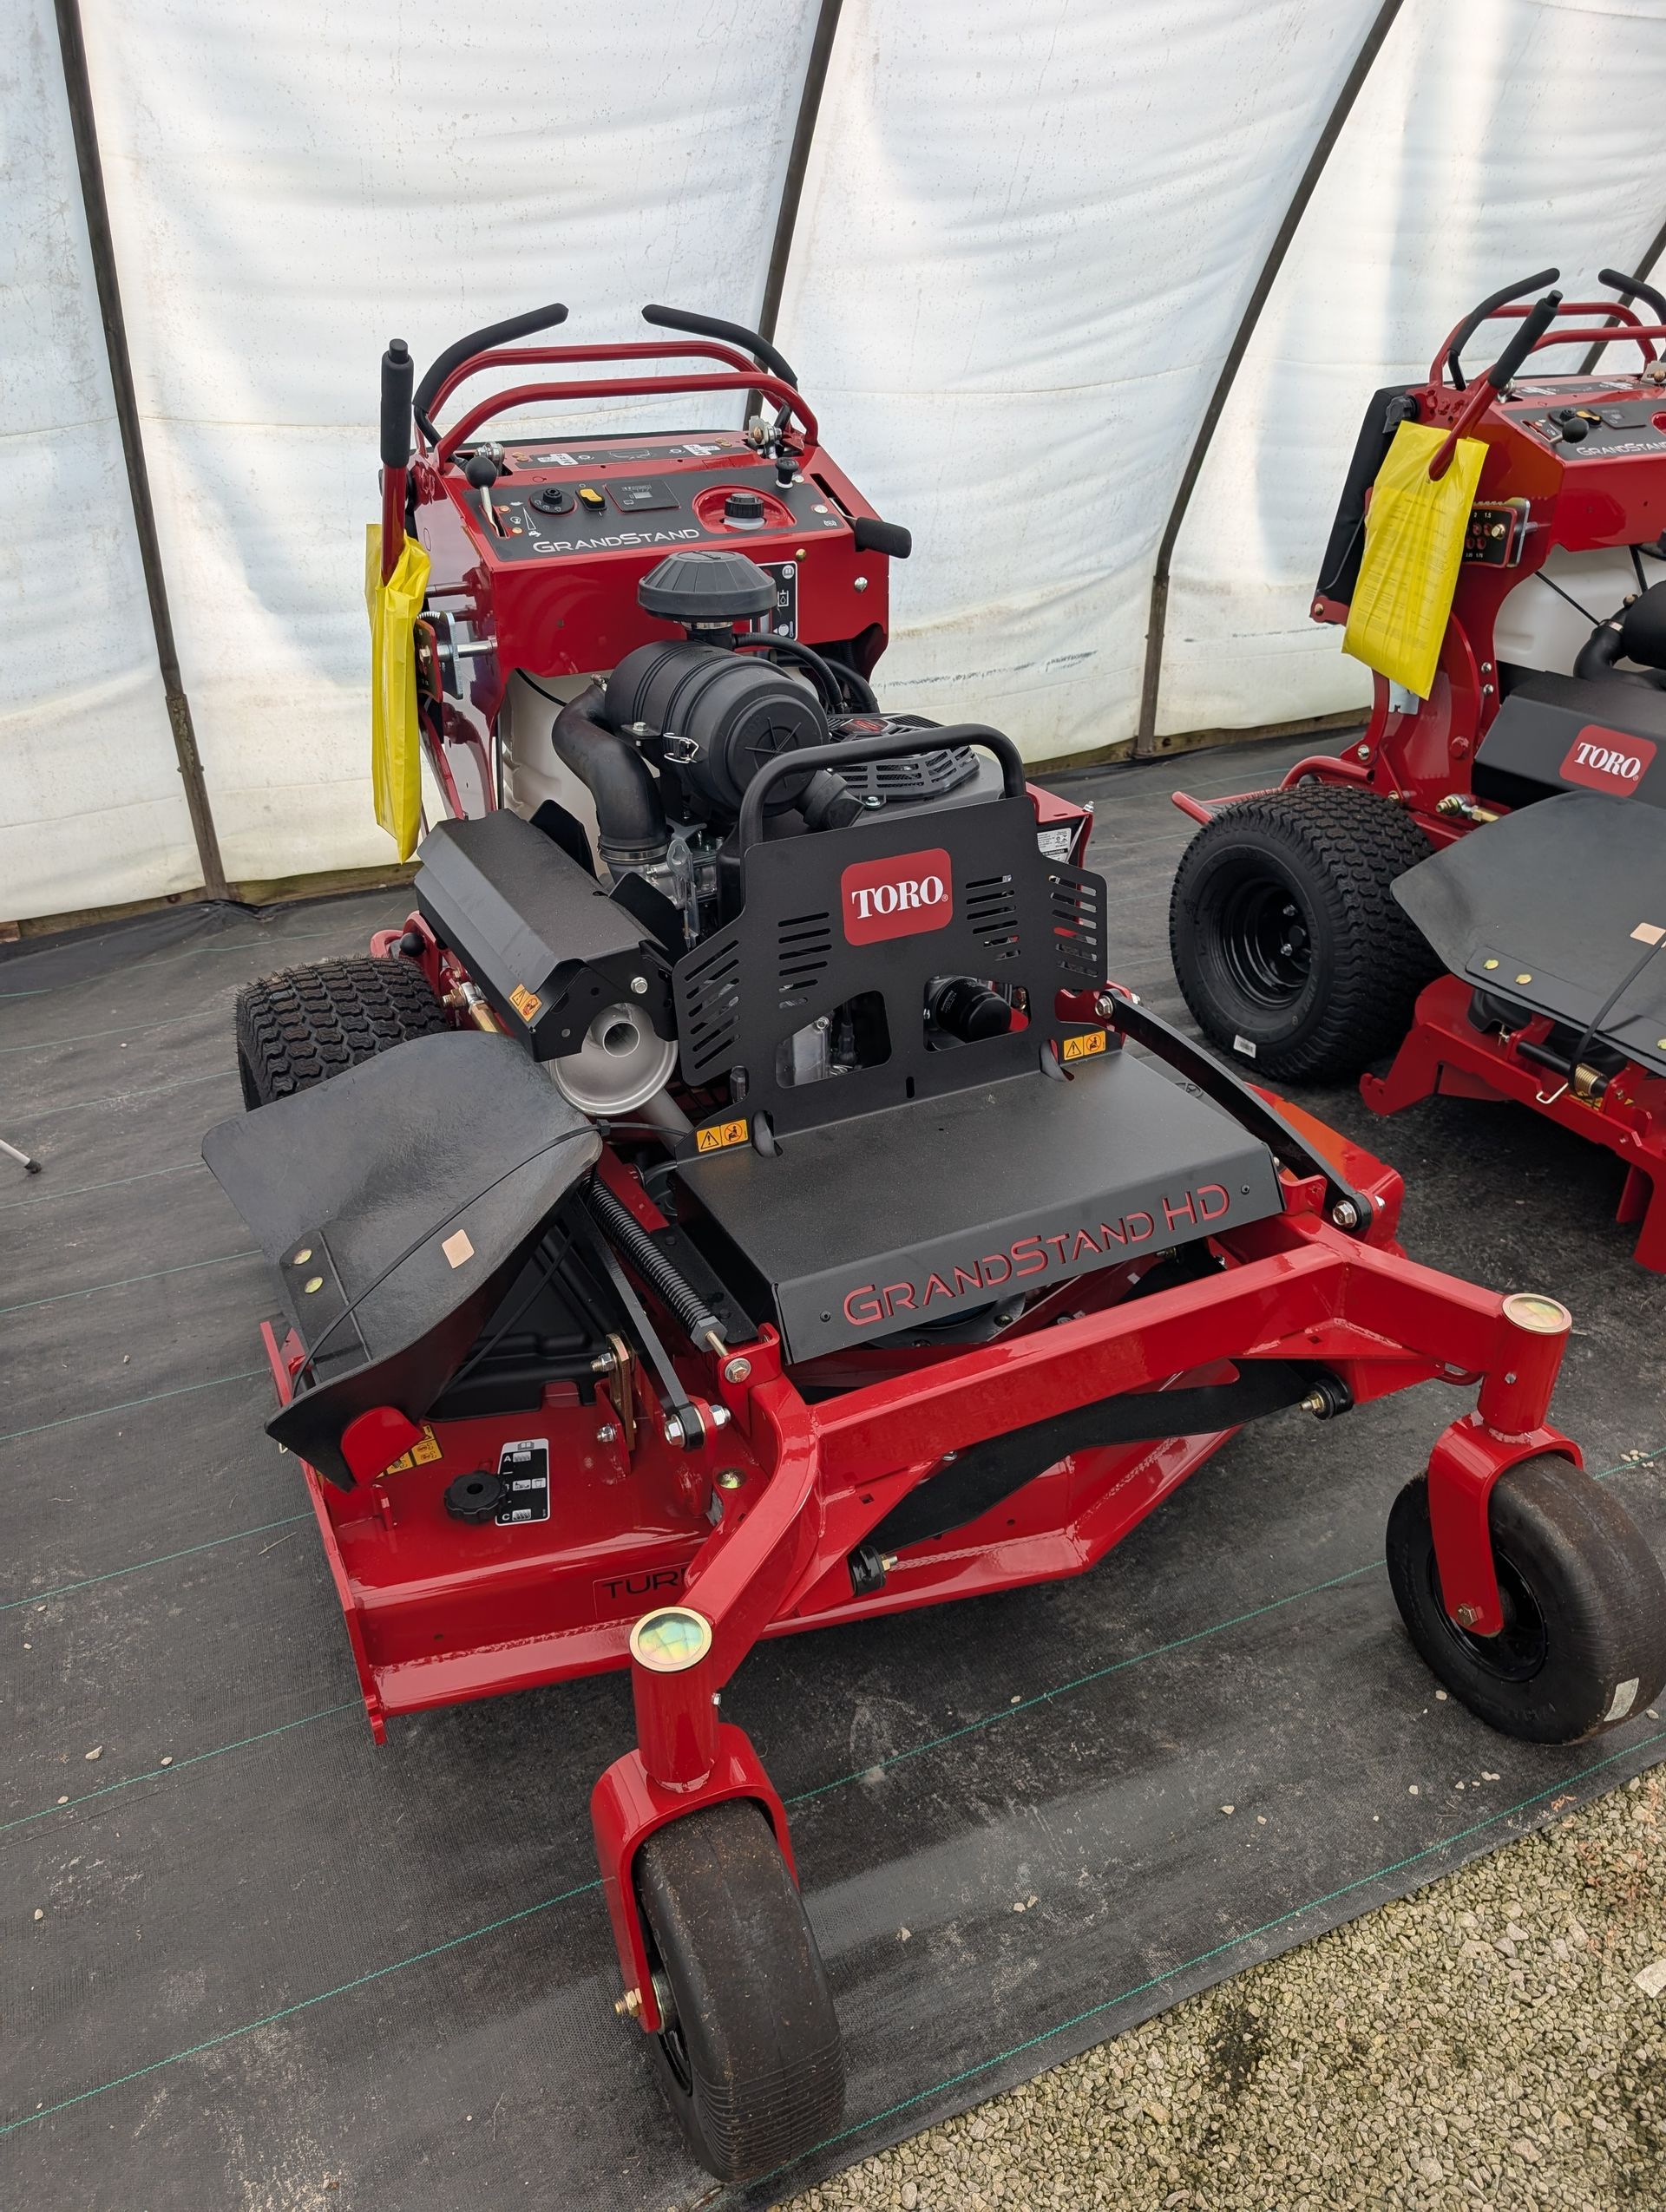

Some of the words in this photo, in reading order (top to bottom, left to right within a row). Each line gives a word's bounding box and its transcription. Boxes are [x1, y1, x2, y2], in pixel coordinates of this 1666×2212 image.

[1574, 742, 1641, 779] TORO
[851, 875, 944, 919] TORO
[843, 1210, 1155, 1325] GRANDSTAND
[1162, 1183, 1230, 1231] HD
